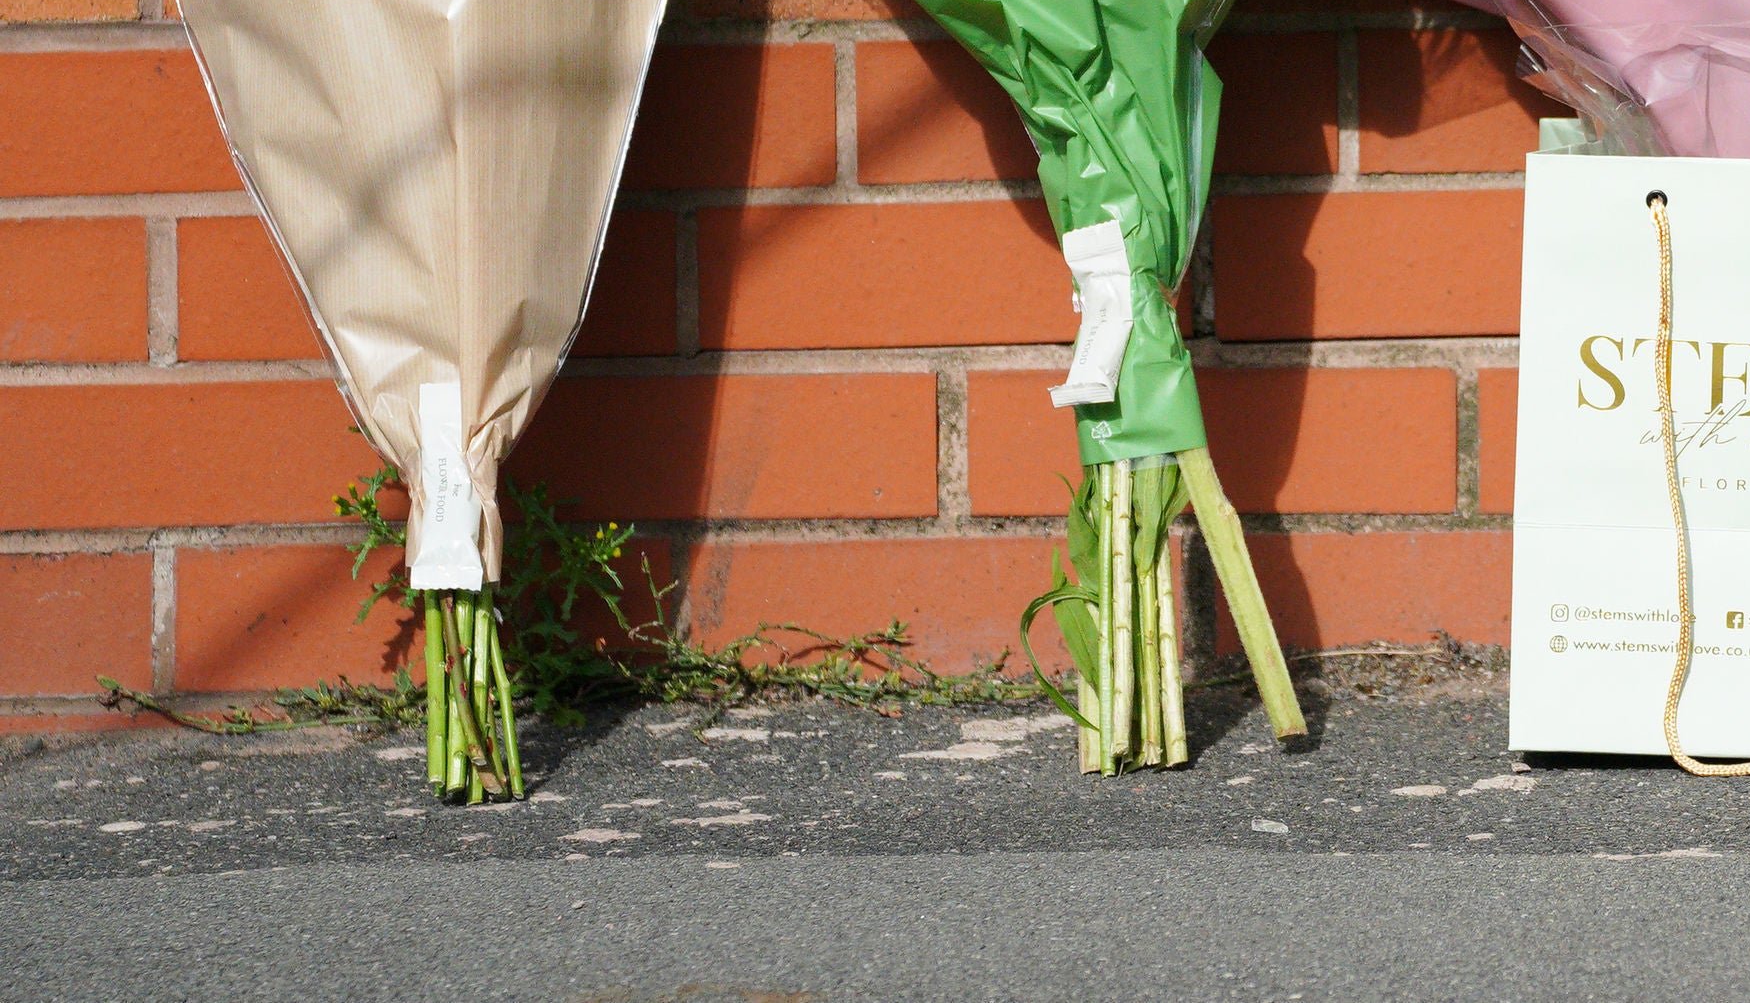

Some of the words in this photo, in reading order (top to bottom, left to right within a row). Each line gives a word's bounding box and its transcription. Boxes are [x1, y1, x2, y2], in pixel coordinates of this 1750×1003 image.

[1639, 399, 1747, 462] with
[435, 495, 446, 522] FOOD
[1574, 605, 1697, 624] @stemswithloe
